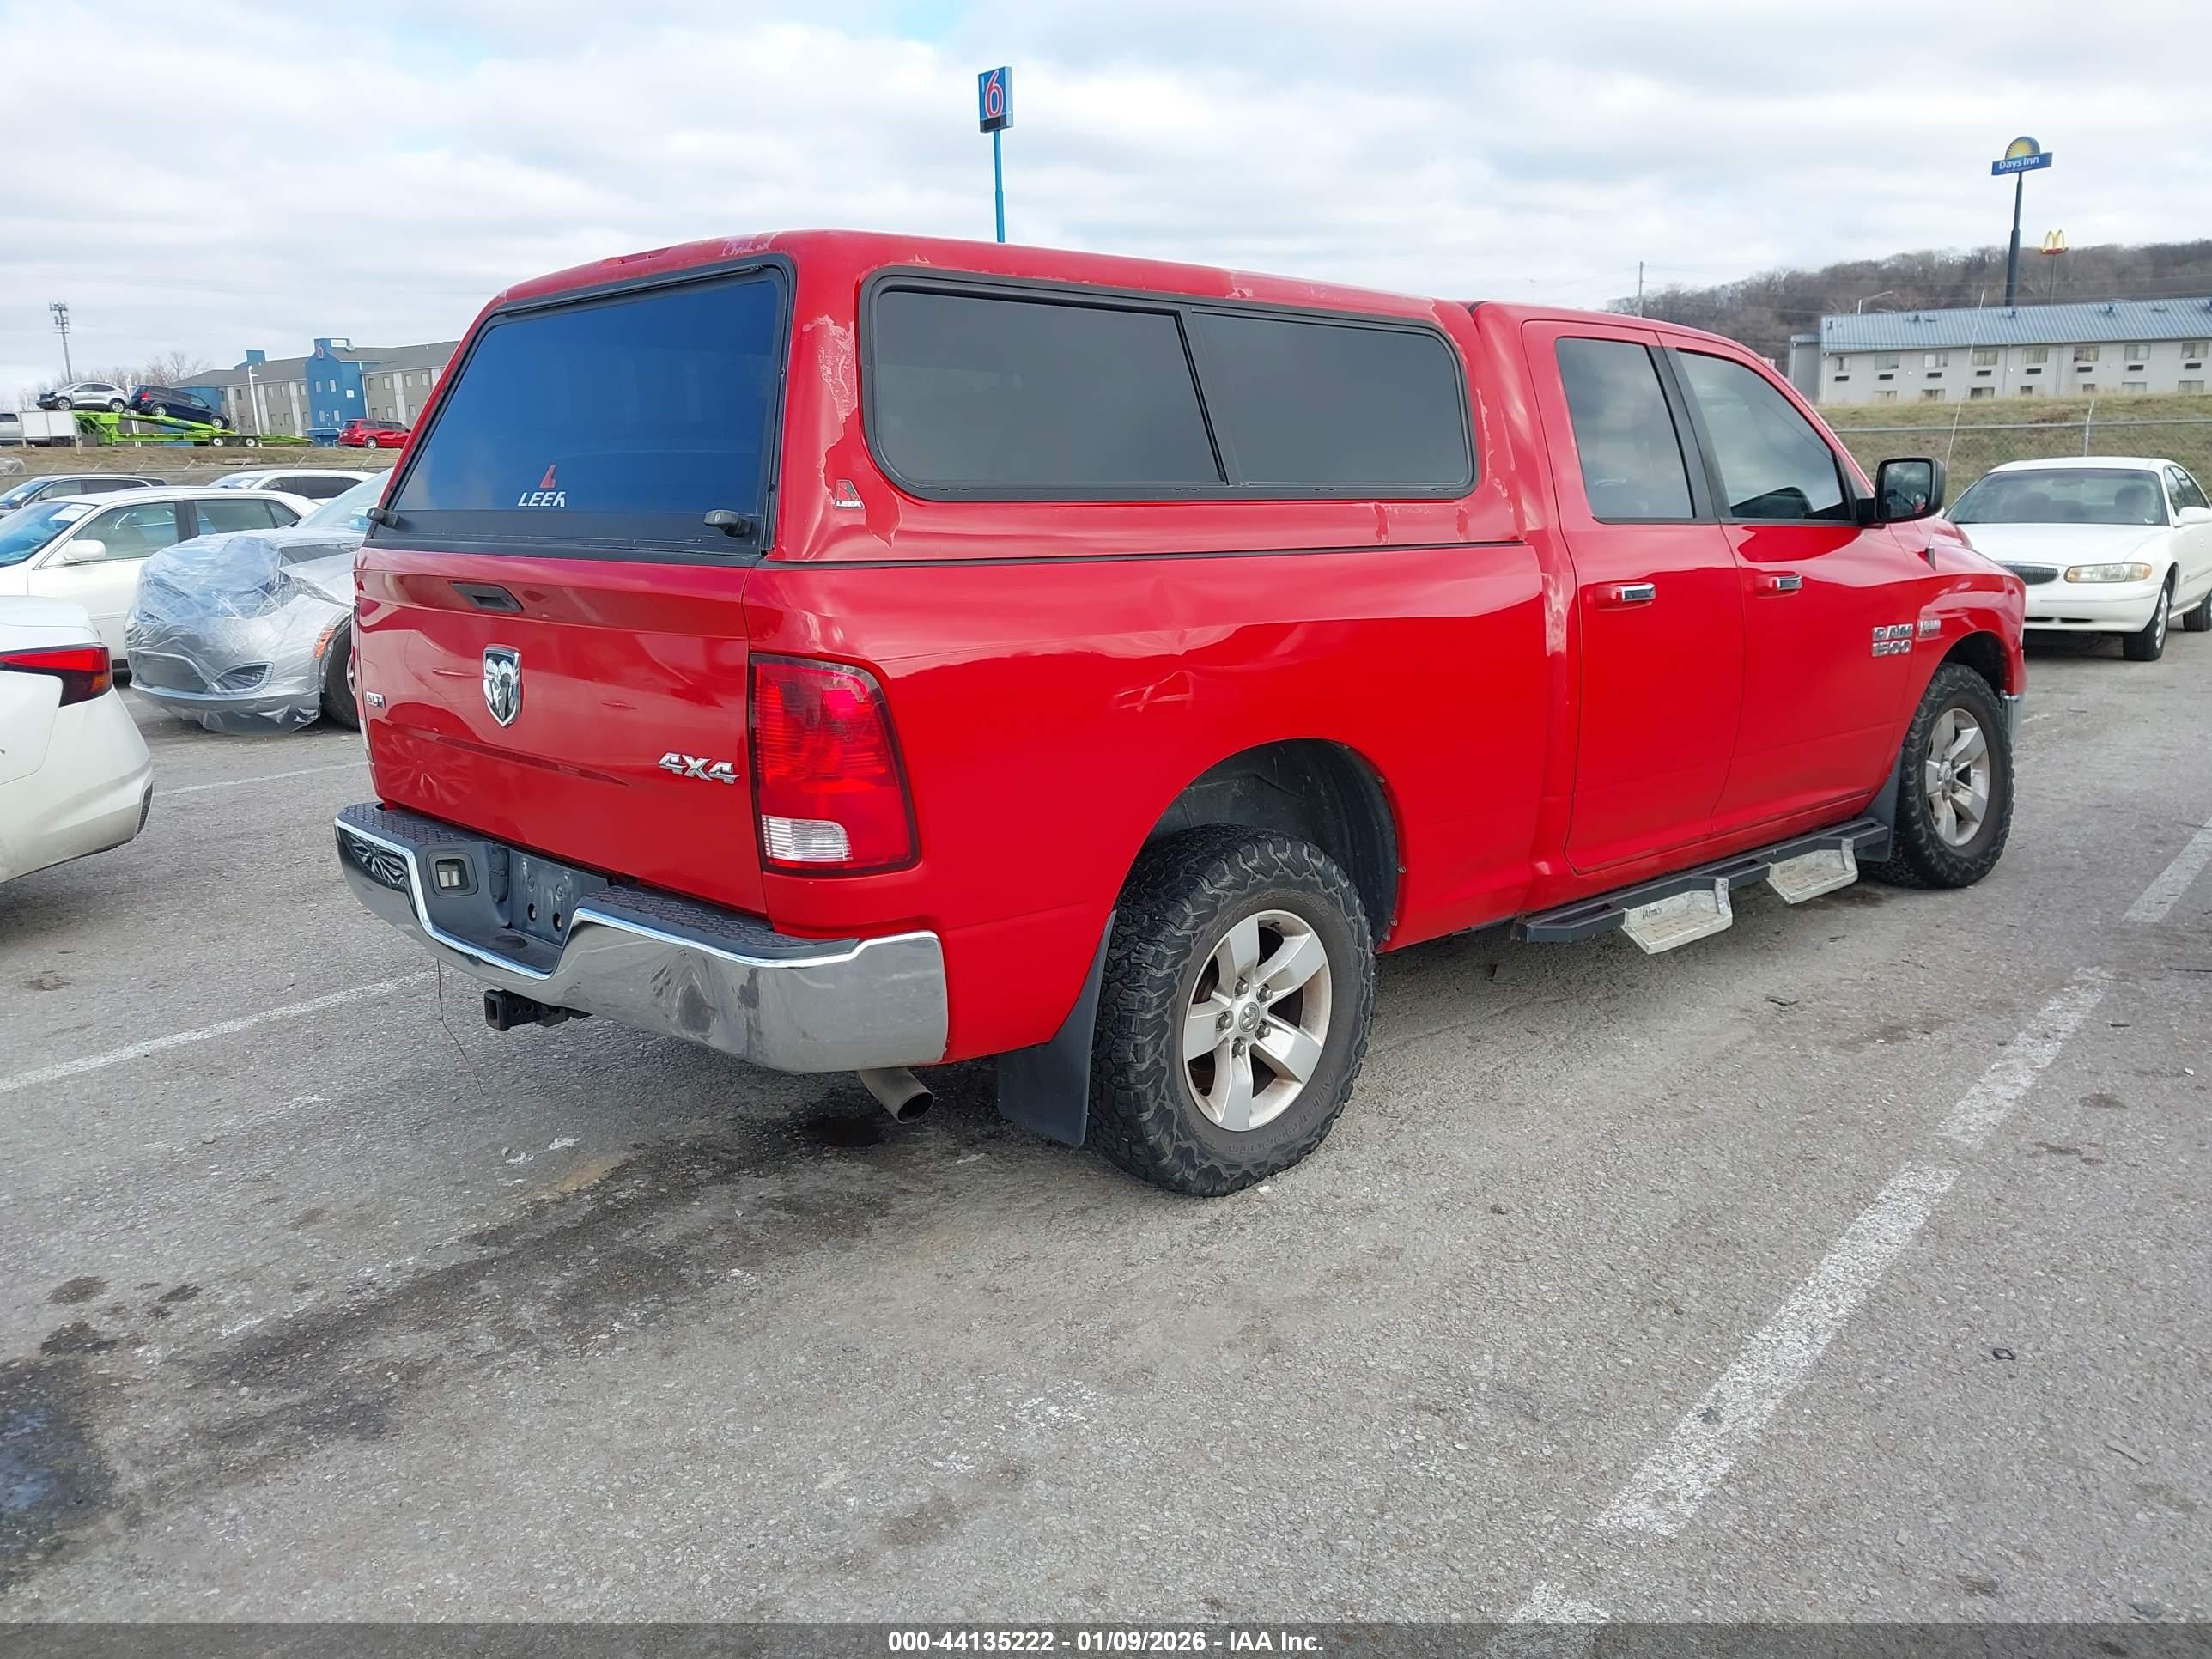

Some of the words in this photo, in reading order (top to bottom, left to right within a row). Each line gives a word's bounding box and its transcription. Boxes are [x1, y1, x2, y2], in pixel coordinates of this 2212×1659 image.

[985, 70, 1004, 118] 6
[1999, 160, 2022, 170] Days
[2023, 156, 2040, 166] Inn
[517, 491, 566, 507] LEER
[1873, 623, 1913, 641] RAM
[1872, 640, 1911, 657] 1500
[367, 694, 383, 707] SLT
